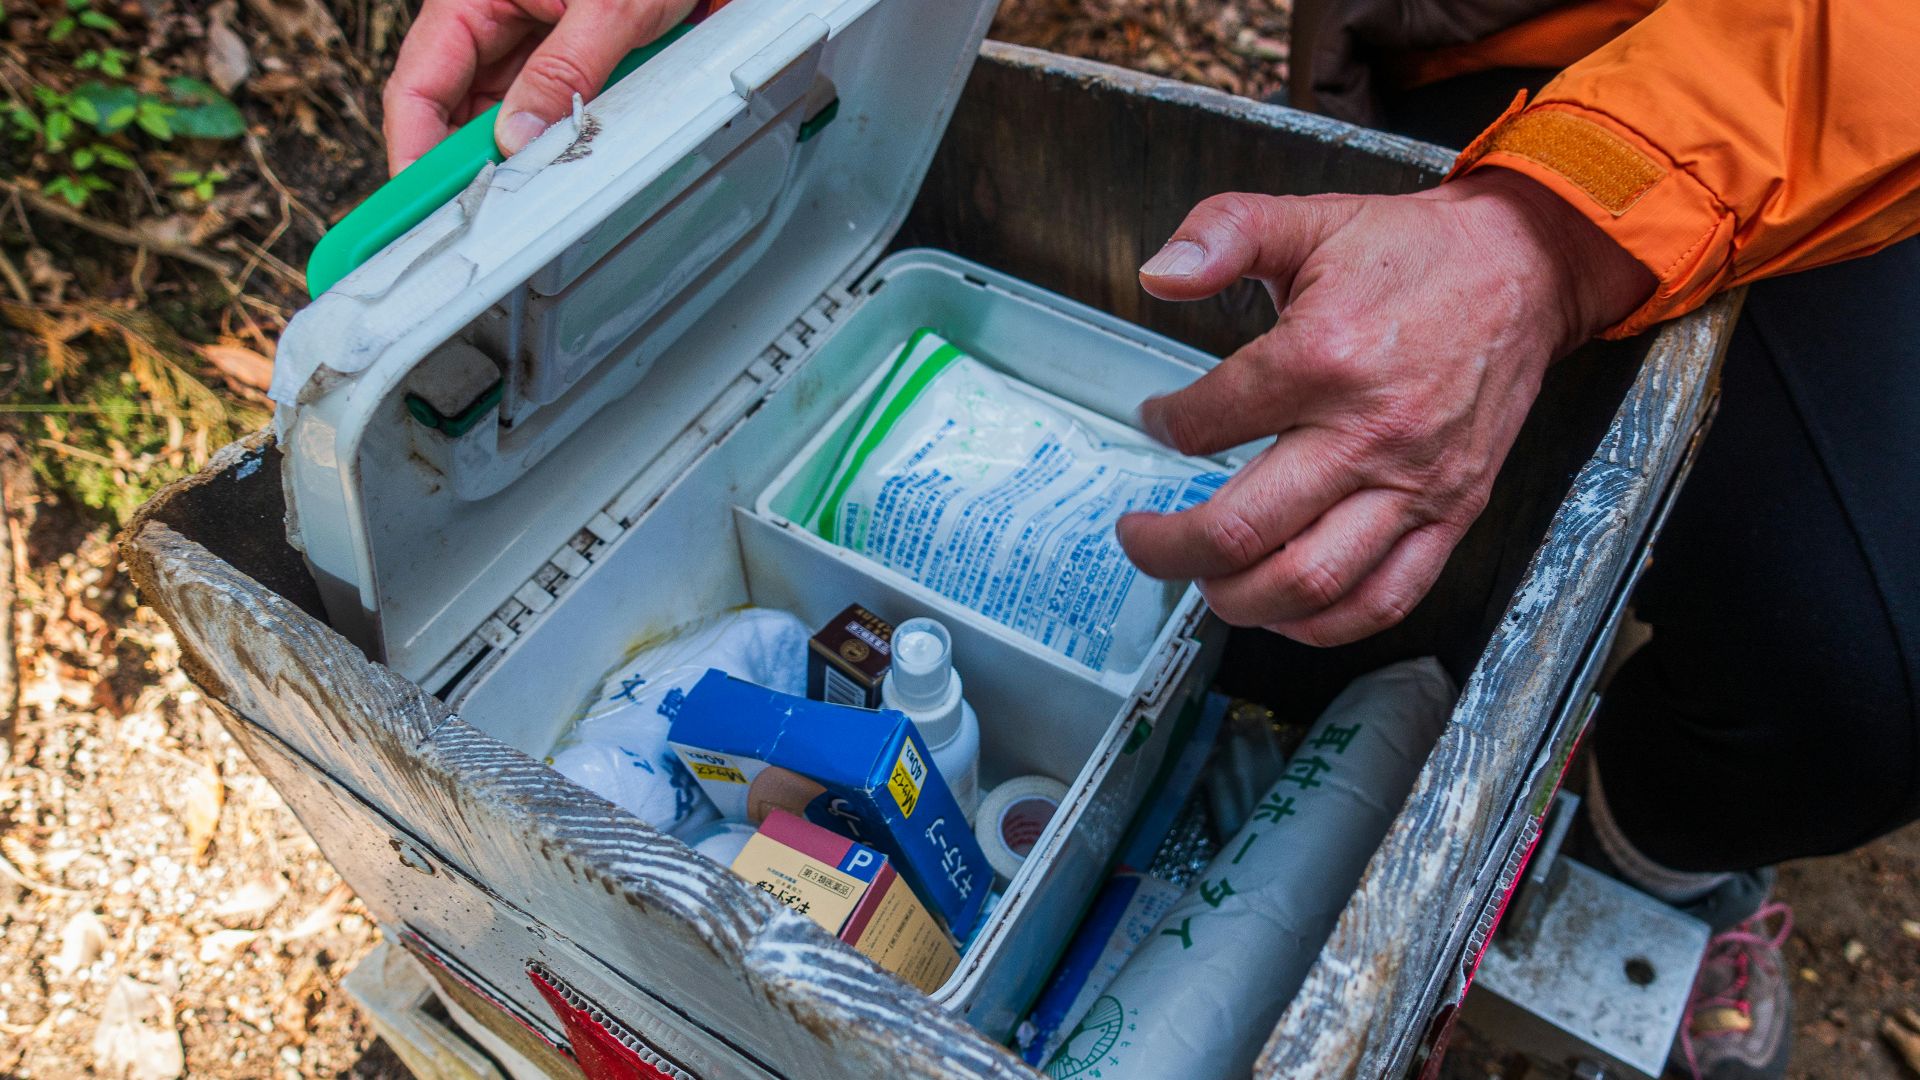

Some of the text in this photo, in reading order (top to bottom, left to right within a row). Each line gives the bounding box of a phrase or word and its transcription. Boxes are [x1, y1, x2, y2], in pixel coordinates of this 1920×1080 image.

[1161, 722, 1362, 950] 耳付ホータイ
[846, 849, 873, 872] P
[802, 867, 851, 897] 第3類医薬品
